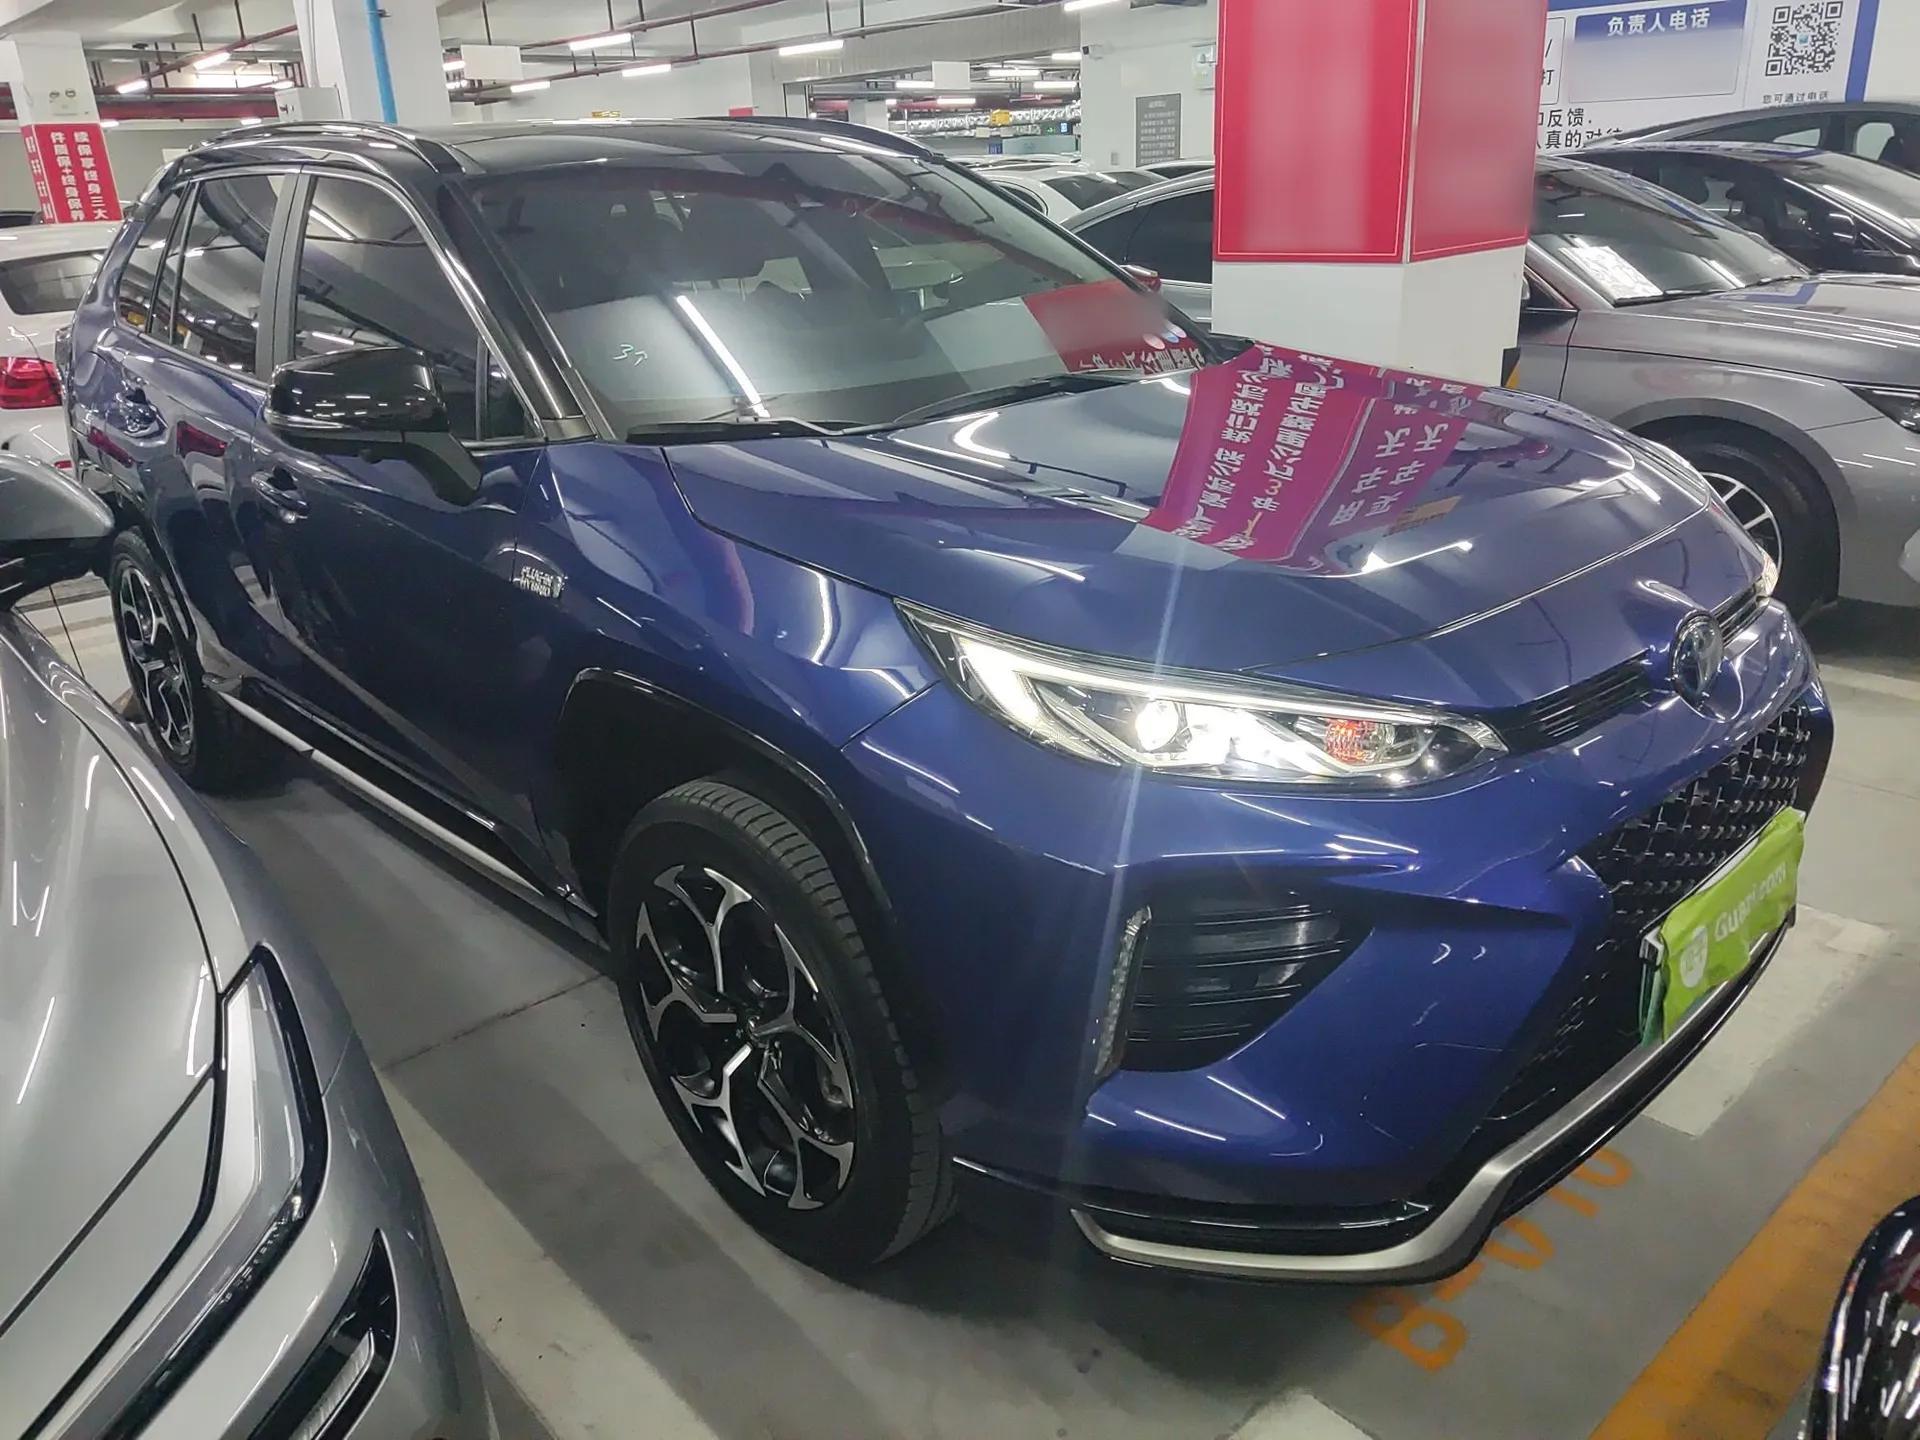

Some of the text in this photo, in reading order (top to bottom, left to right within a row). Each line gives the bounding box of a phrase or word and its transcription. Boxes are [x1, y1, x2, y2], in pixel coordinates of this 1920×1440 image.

[1607, 7, 1710, 37] 负责人电话
